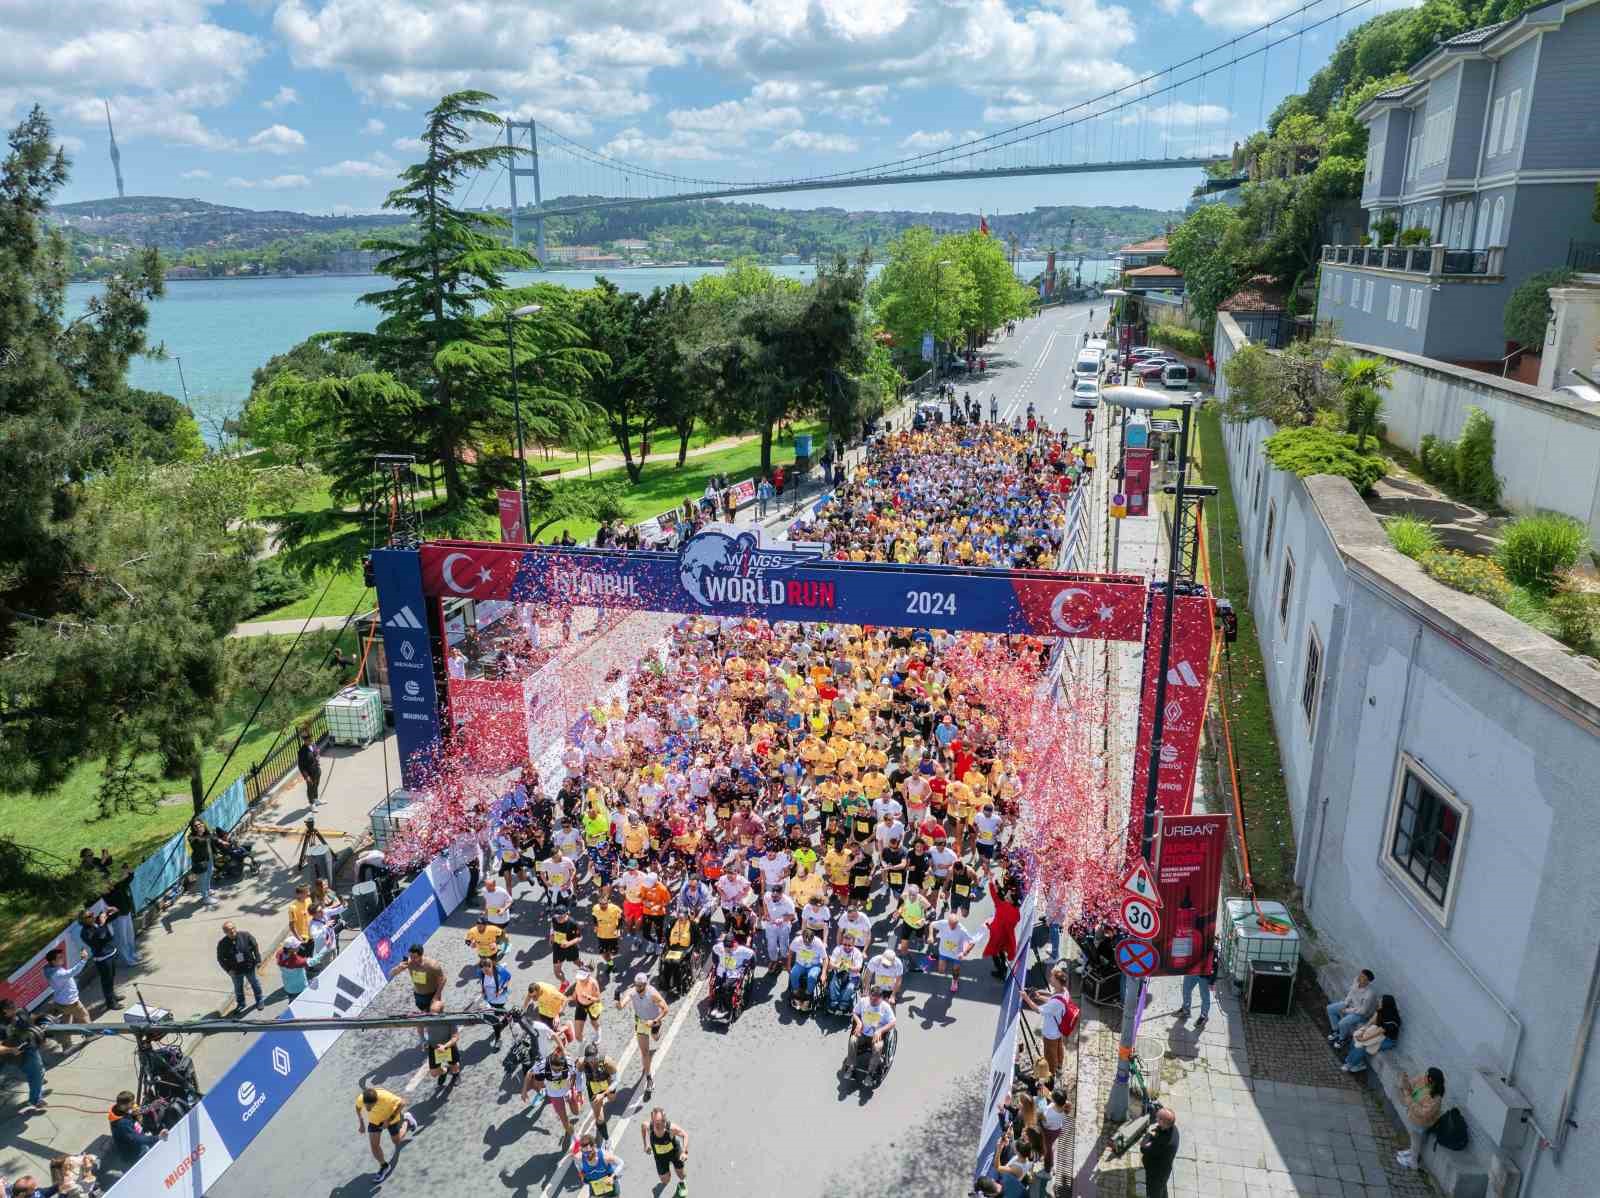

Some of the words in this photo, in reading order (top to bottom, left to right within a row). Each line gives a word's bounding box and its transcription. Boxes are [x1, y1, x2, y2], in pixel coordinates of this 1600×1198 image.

[726, 552, 782, 568] WINGS
[705, 576, 785, 605] WORLD
[787, 580, 836, 609] RUN
[906, 591, 957, 616] 2024
[1164, 824, 1213, 837] URBAN
[1129, 905, 1151, 930] 30
[242, 1092, 267, 1122] Castrol
[163, 1143, 206, 1189] MIGROS
